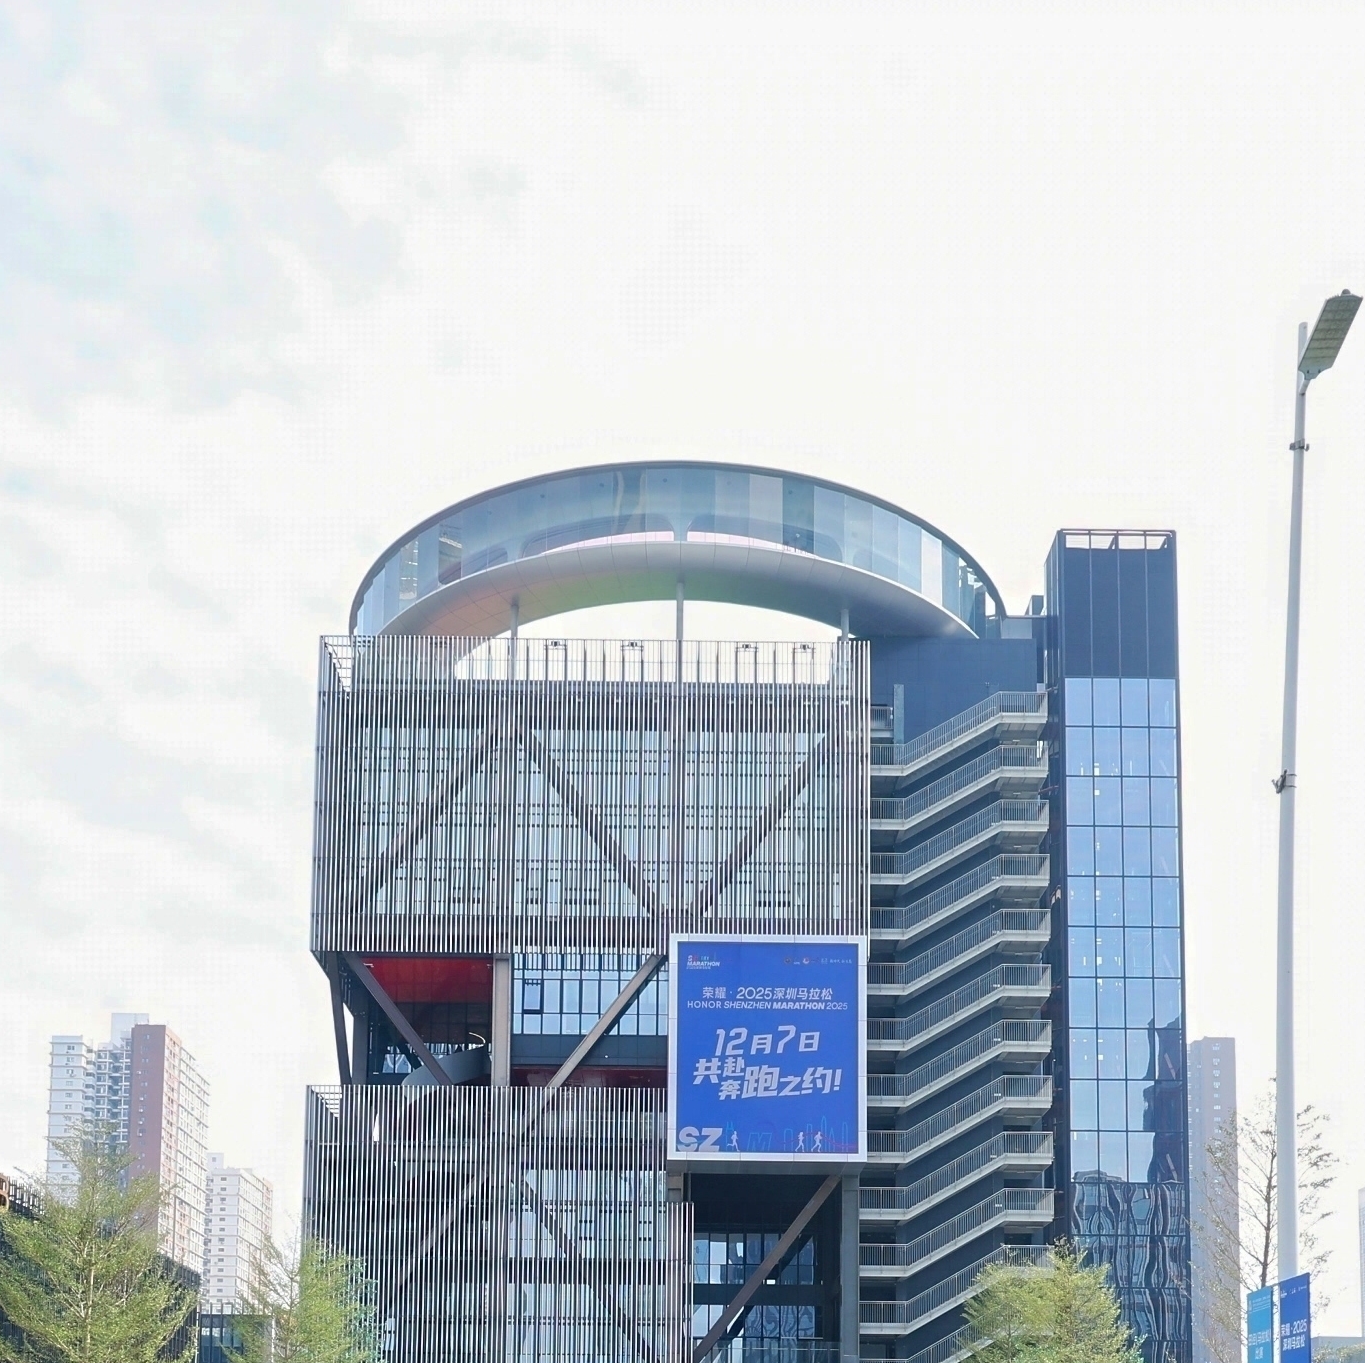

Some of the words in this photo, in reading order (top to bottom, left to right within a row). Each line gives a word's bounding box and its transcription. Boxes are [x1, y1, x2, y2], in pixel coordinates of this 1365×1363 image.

[687, 1001, 722, 1009] HONOR
[723, 1001, 771, 1010] SHENZHEN
[772, 1002, 825, 1010] MARATHON
[826, 1002, 848, 1010] 2025
[714, 1025, 821, 1056] 12月7日
[678, 1126, 723, 1152] SZ
